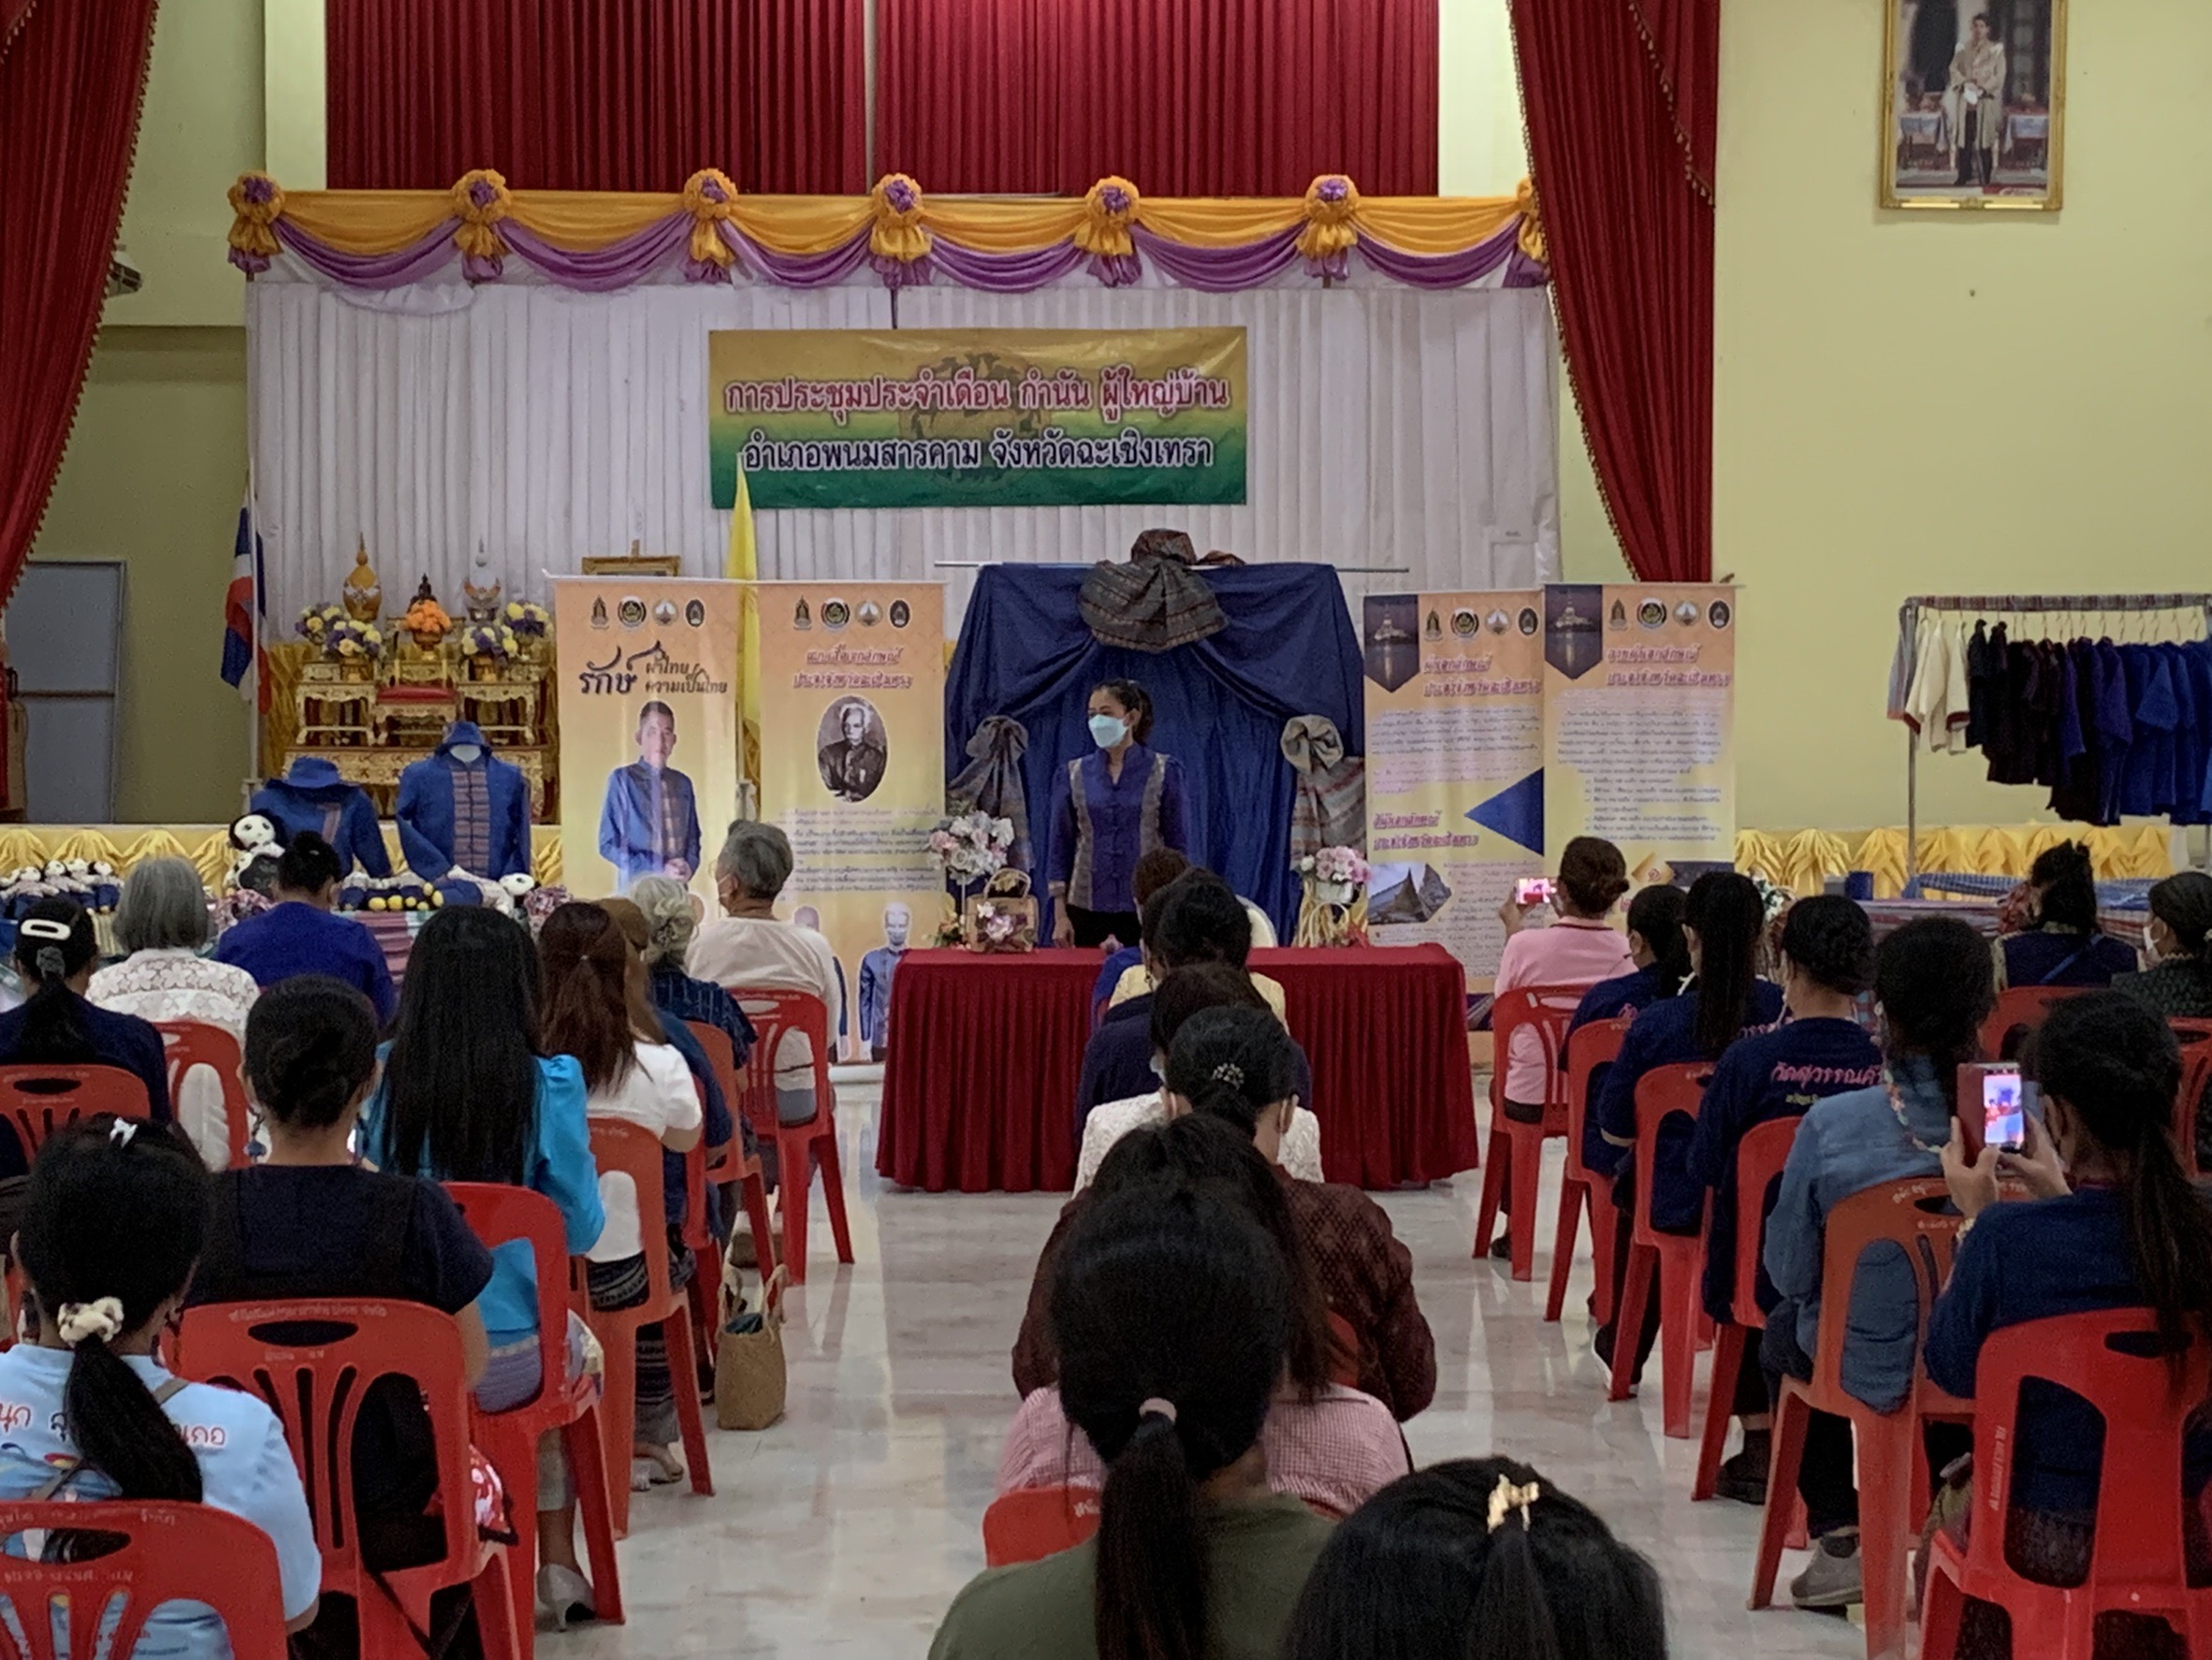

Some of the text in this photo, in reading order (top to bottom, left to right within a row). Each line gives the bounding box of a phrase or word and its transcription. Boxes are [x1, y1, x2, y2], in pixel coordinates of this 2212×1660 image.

[726, 364, 1229, 425] การประชุมประจำเดือน กำนัน ผู้ใหญ่บ้าน
[744, 427, 1214, 471] อำเภอพนมสารคาม จังหวัดฉะเชิงเทรา
